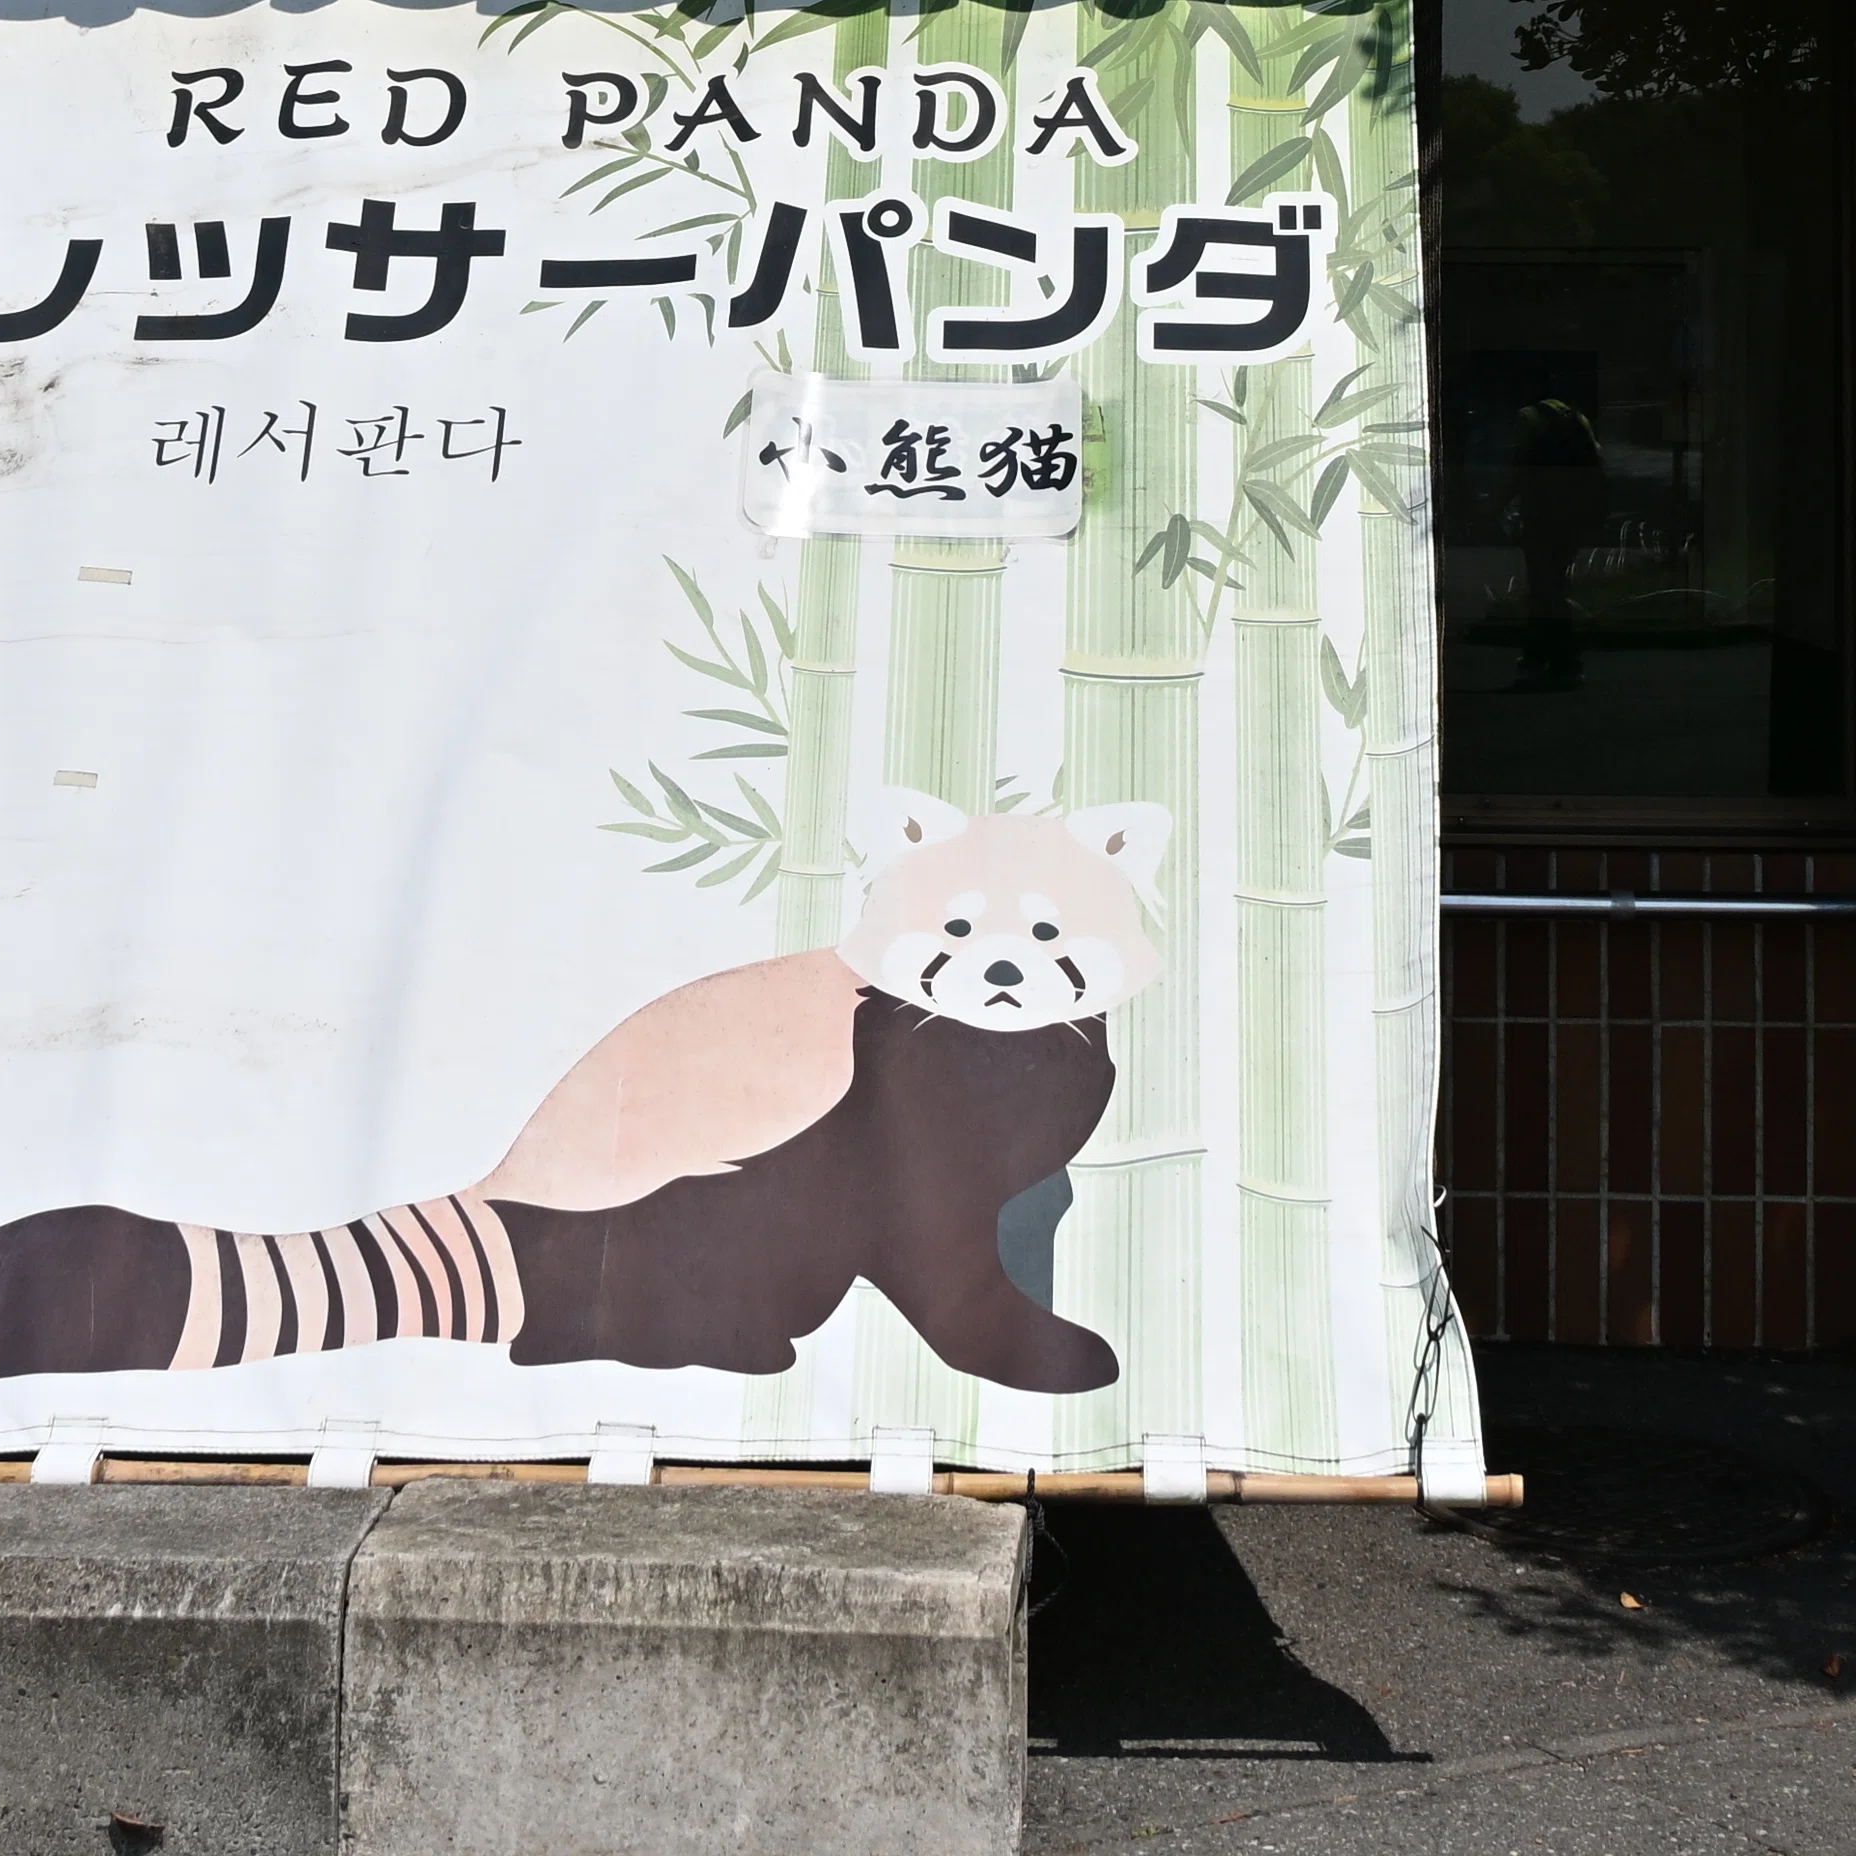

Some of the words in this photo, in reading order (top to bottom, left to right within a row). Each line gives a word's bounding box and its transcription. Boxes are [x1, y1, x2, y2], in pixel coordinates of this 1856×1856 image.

[165, 58, 470, 148] RED
[560, 70, 1129, 158] PANDA
[150, 399, 524, 486] 레서판다
[758, 417, 1080, 502] 小熊猫
